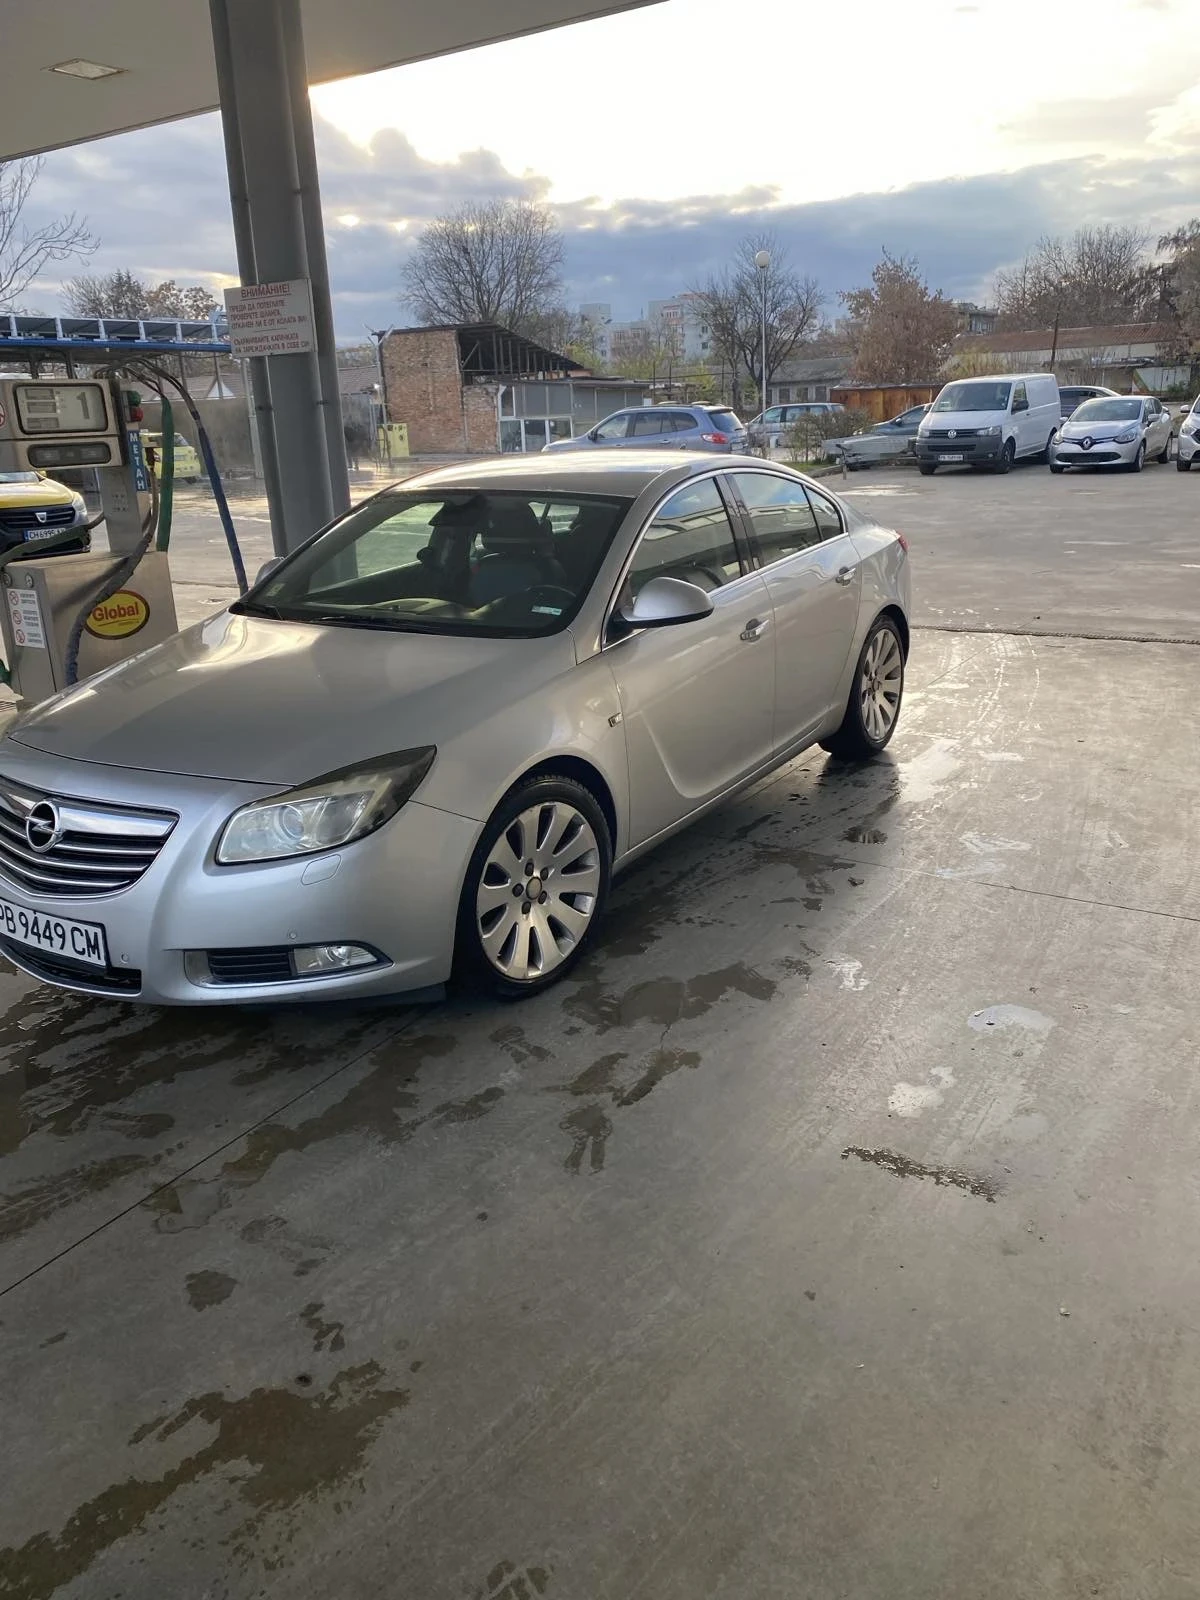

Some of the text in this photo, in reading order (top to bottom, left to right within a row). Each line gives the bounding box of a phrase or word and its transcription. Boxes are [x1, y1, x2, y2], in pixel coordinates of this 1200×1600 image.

[241, 284, 290, 298] ВНИМАНИЕ!
[76, 392, 90, 420] 1
[130, 432, 145, 490] МЕТАН
[92, 602, 139, 621] Global
[19, 912, 65, 950] 9449
[71, 926, 101, 960] CM
